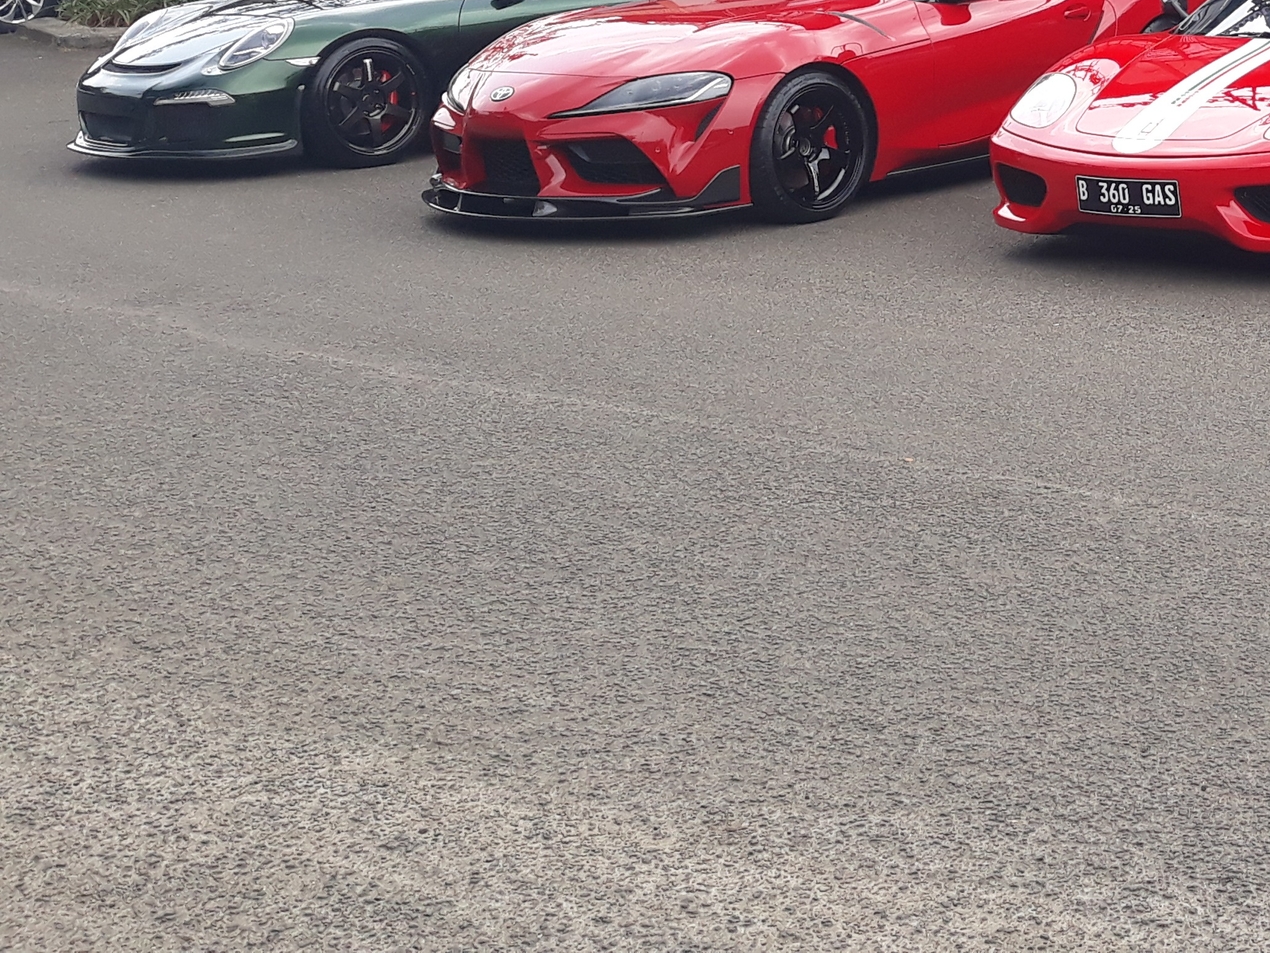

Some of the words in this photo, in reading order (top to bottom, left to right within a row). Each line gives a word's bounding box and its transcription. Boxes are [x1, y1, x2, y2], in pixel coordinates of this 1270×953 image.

[1078, 180, 1088, 201] B
[1098, 182, 1130, 204] 360
[1142, 184, 1176, 205] GAS
